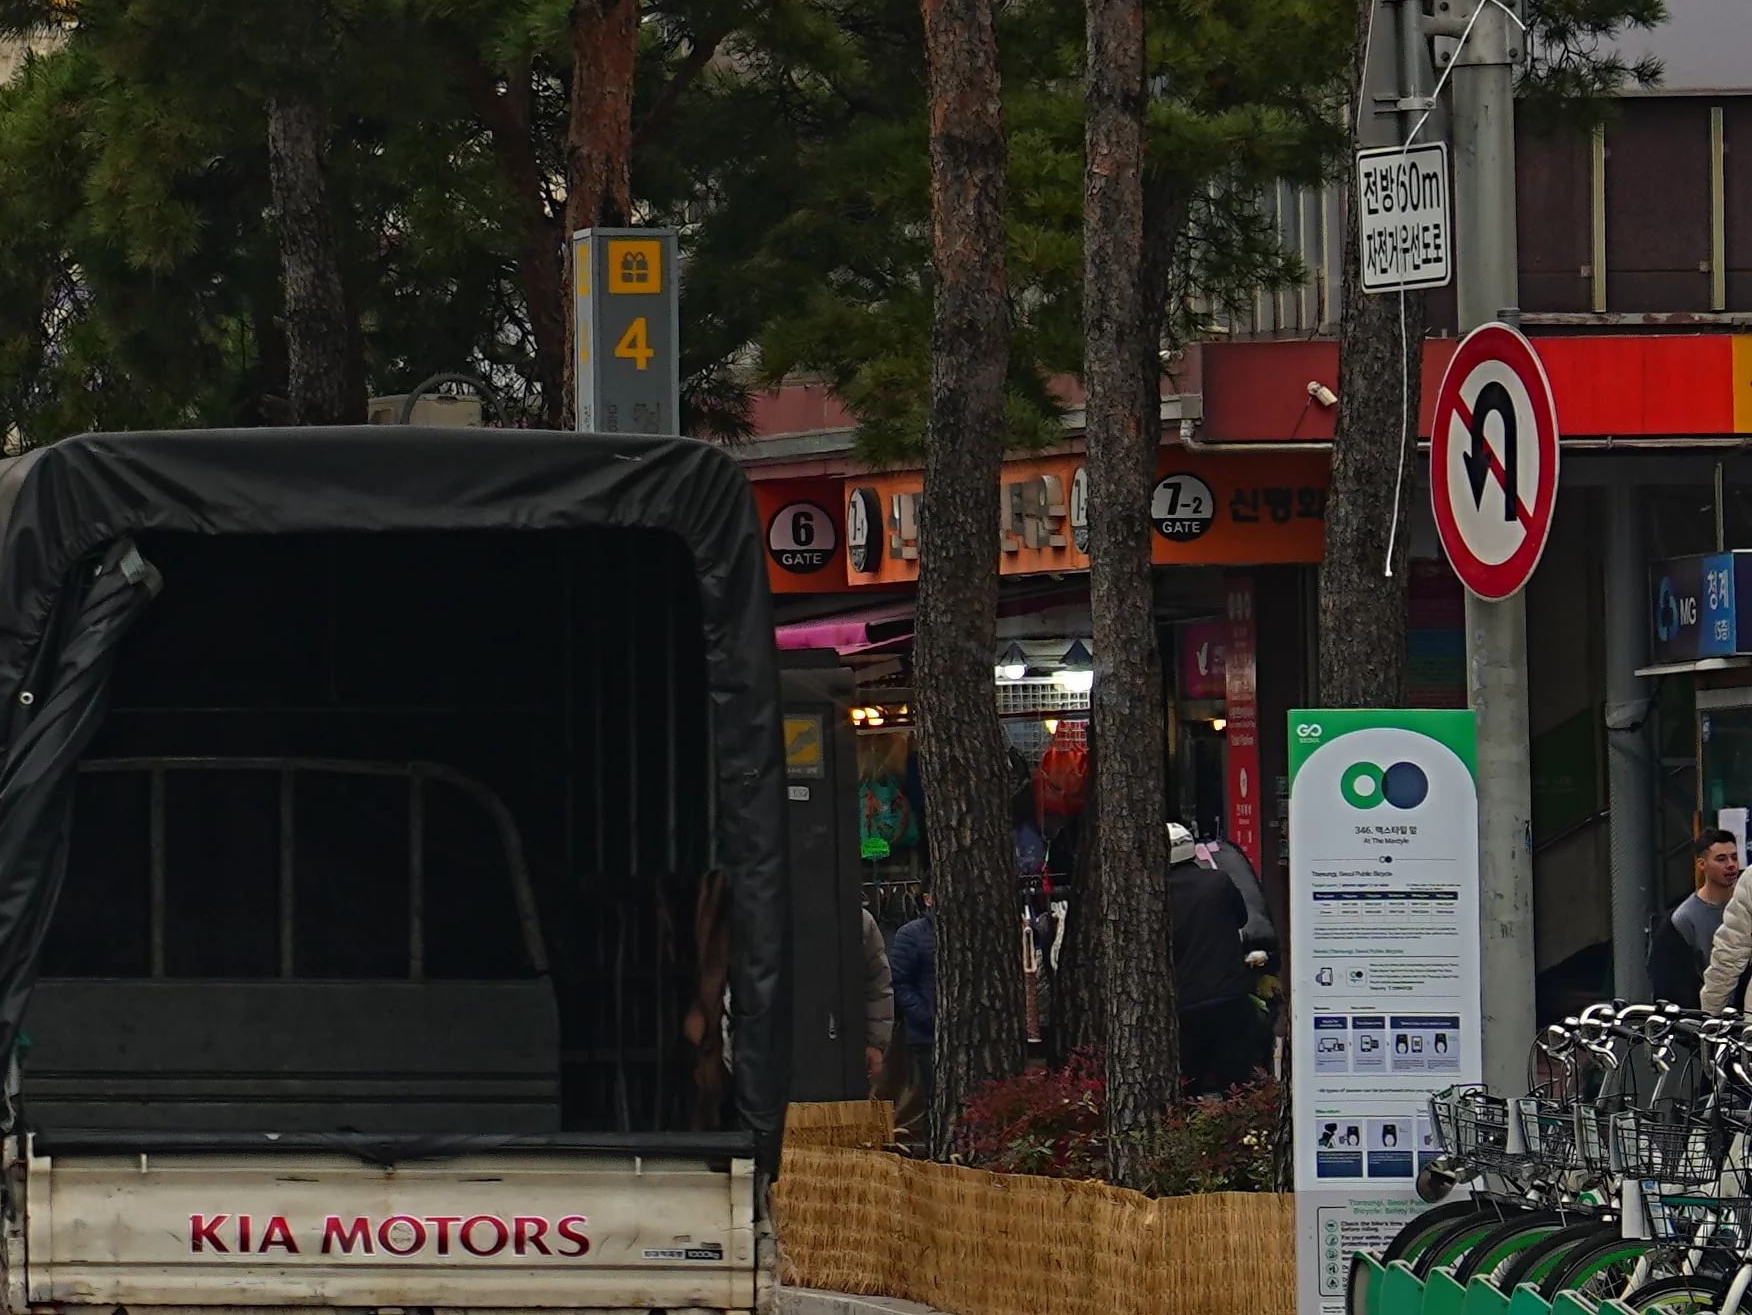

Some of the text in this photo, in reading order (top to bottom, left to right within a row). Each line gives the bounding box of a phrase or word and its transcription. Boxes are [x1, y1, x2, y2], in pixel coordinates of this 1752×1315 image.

[1366, 222, 1443, 276] 자전거우선도로
[614, 317, 655, 370] 4
[1162, 482, 1203, 516] 7-2
[791, 511, 814, 547] 6
[1162, 521, 1201, 534] GATE
[782, 551, 822, 565] GATE
[1680, 597, 1697, 626] MG
[189, 1213, 592, 1257] KIA MOTORS
